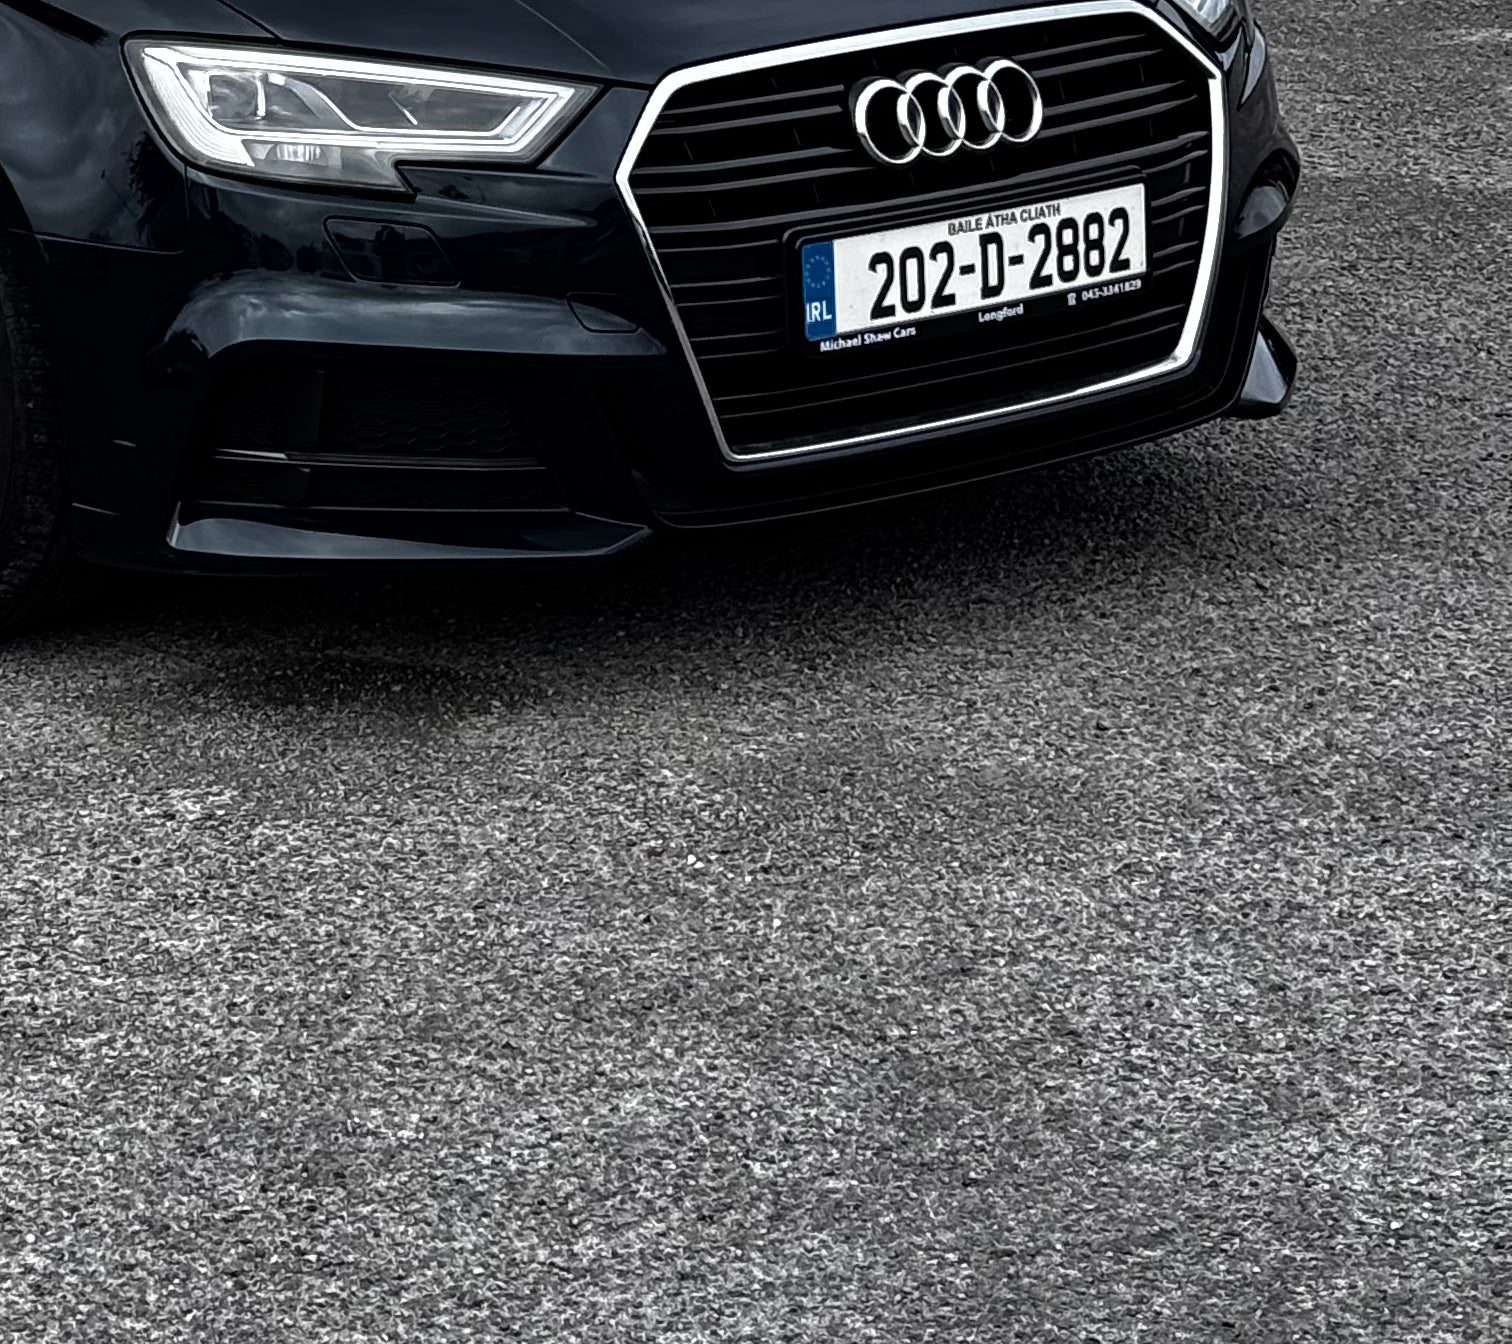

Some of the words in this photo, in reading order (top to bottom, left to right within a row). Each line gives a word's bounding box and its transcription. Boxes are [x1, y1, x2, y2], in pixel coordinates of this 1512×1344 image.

[1020, 202, 1061, 223] CLIATH
[868, 207, 1131, 322] 202-D-2882
[806, 300, 833, 322] IRL
[978, 303, 1024, 323] Longford
[820, 333, 862, 352] Michael
[863, 331, 892, 345] Shaw
[893, 326, 917, 339] Cars
